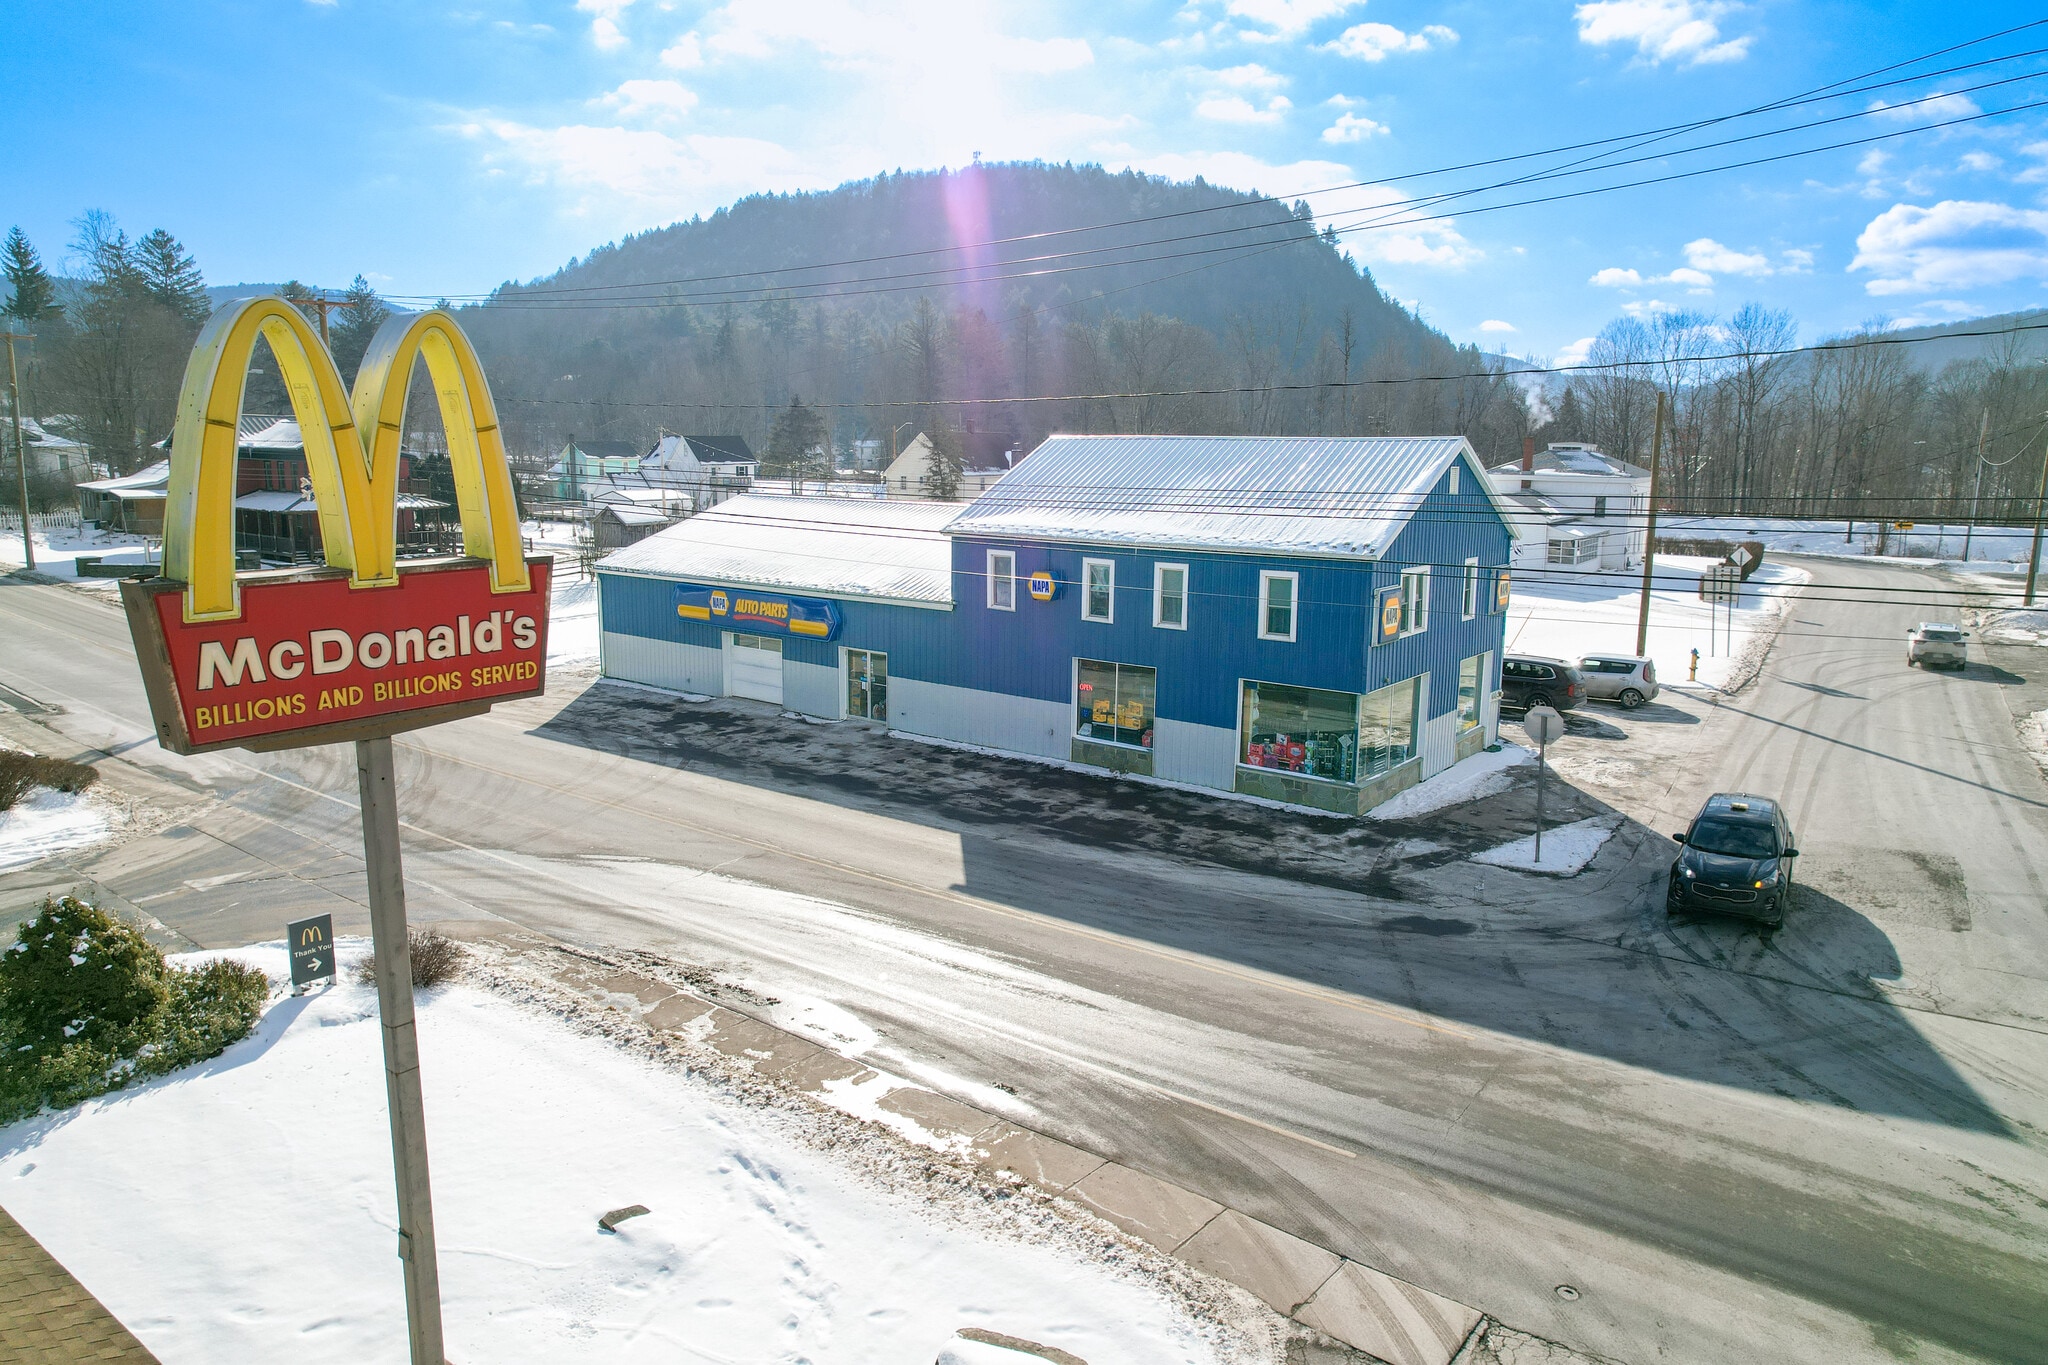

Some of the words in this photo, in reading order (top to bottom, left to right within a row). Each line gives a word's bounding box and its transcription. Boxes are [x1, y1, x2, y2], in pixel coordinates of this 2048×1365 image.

[1032, 578, 1050, 593] NAPA
[711, 596, 727, 611] NAPA
[735, 599, 759, 615] AUTO
[759, 601, 789, 619] PARTS
[196, 609, 538, 691] McDonald's
[195, 692, 307, 730] BILLIONS
[317, 685, 365, 711] AND
[373, 673, 463, 703] BILLIONS
[470, 661, 538, 688] SERVED
[1079, 683, 1093, 691] OPEN
[294, 947, 317, 958] Thank
[317, 943, 333, 952] You
